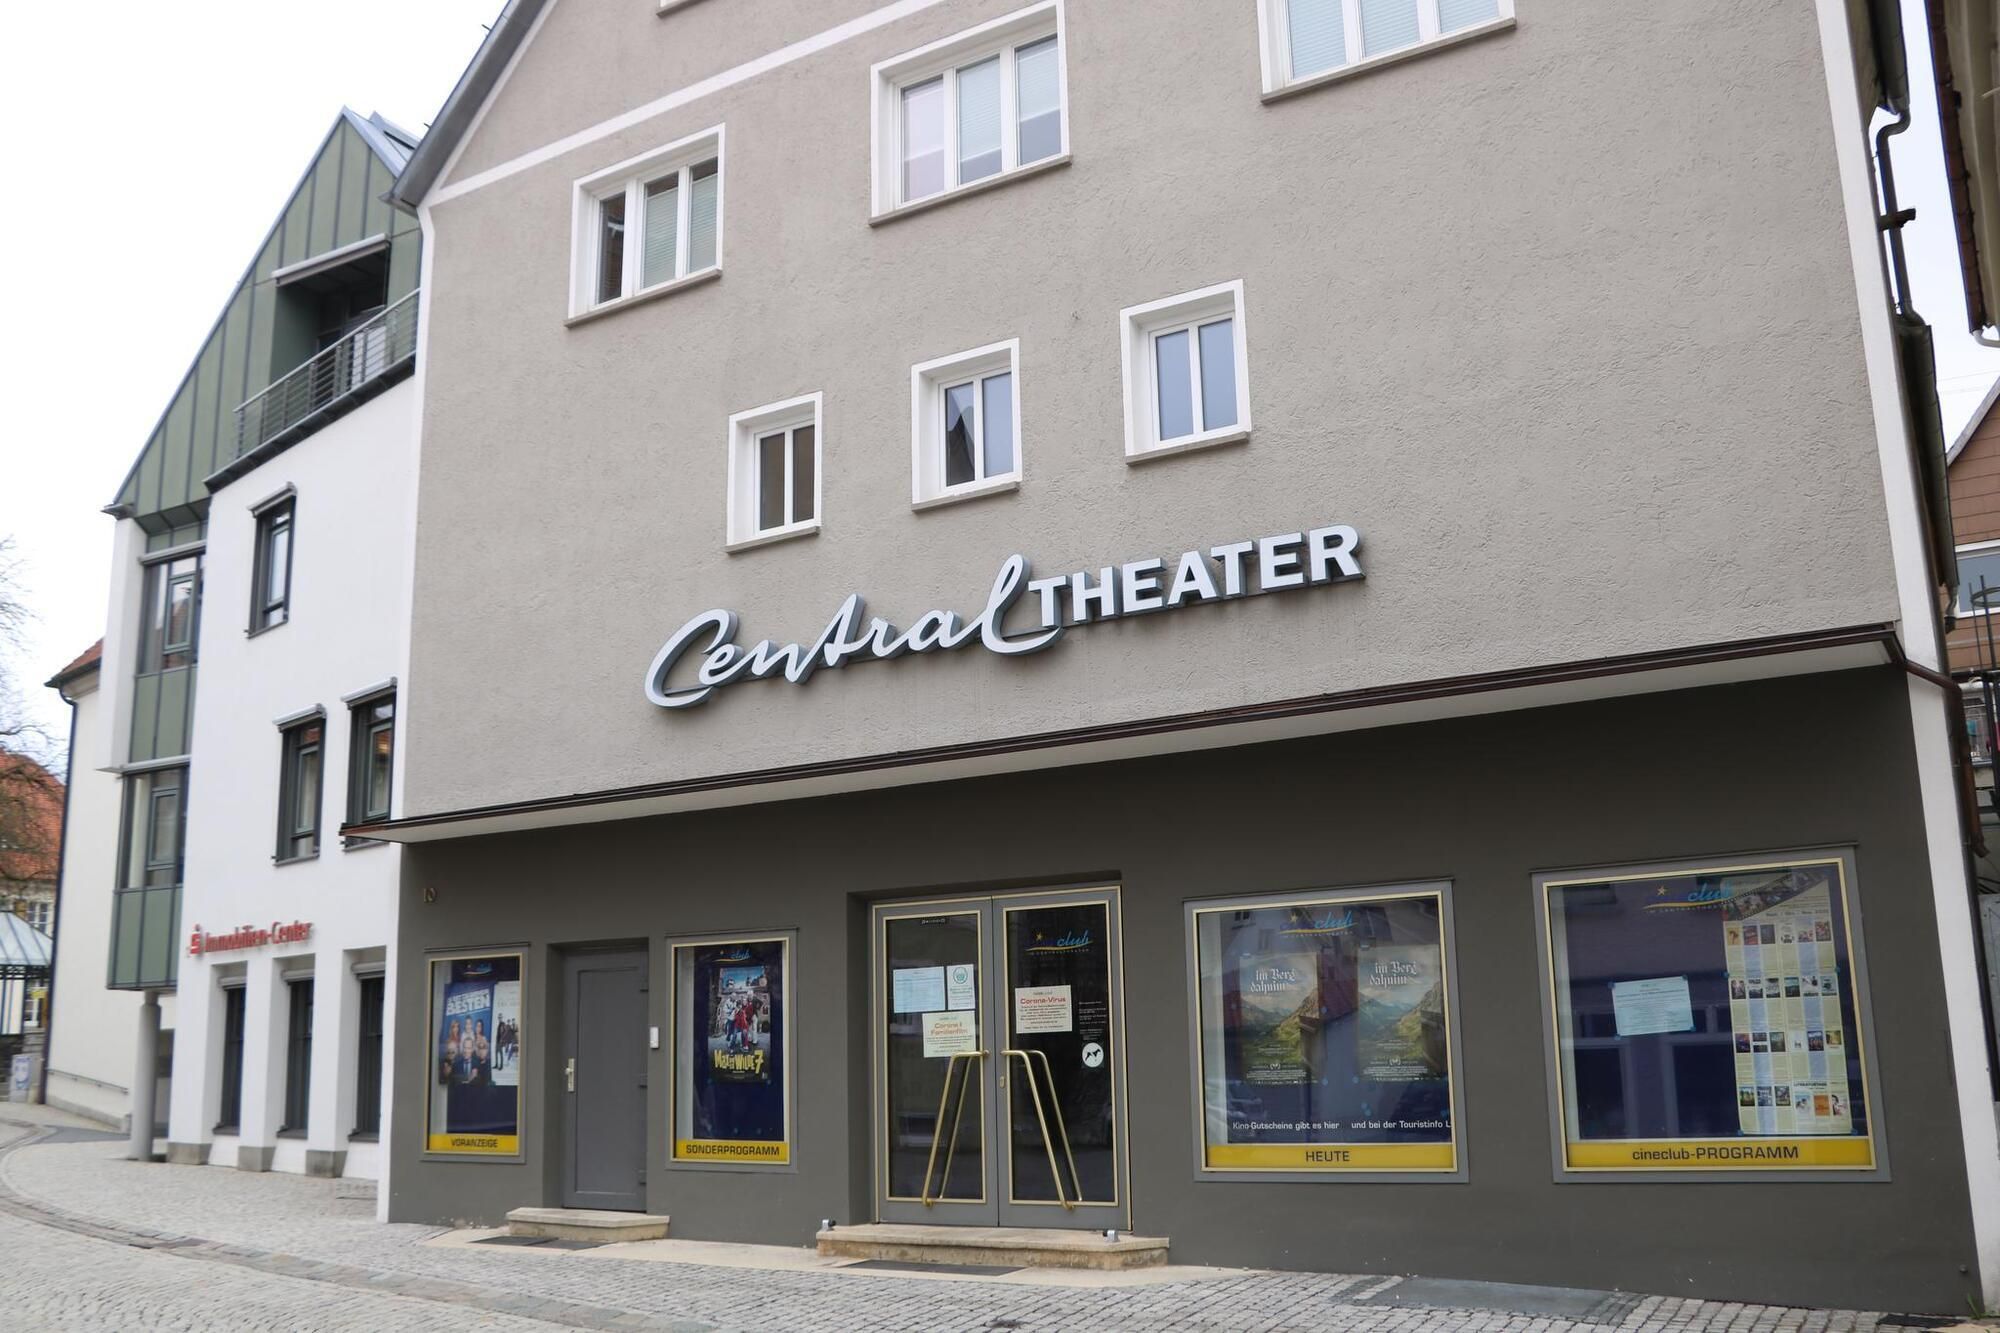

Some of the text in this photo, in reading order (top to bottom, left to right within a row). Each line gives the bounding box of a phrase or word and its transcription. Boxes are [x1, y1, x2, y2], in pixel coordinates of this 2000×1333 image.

[644, 523, 1367, 711] Central THEATER
[1390, 960, 1417, 975] Berg
[1271, 968, 1297, 983] Berg
[1020, 996, 1066, 1005] Corona-Virus
[754, 1049, 764, 1074] 7
[1232, 1121, 1293, 1130] Kino-Gutscheine
[1295, 1121, 1310, 1131] gibt
[1312, 1122, 1322, 1130] es
[1324, 1121, 1340, 1130] hier
[1351, 1121, 1367, 1129] und
[1368, 1120, 1381, 1129] bei
[1383, 1120, 1397, 1129] der
[1399, 1119, 1443, 1129] Touristinfo
[451, 1138, 498, 1148] VORANZEIGE
[685, 1143, 780, 1156] SONDERPROGRAMM
[1305, 1150, 1350, 1163] HEUTE
[1632, 1146, 1799, 1161] cineclub-PROGRAMM
